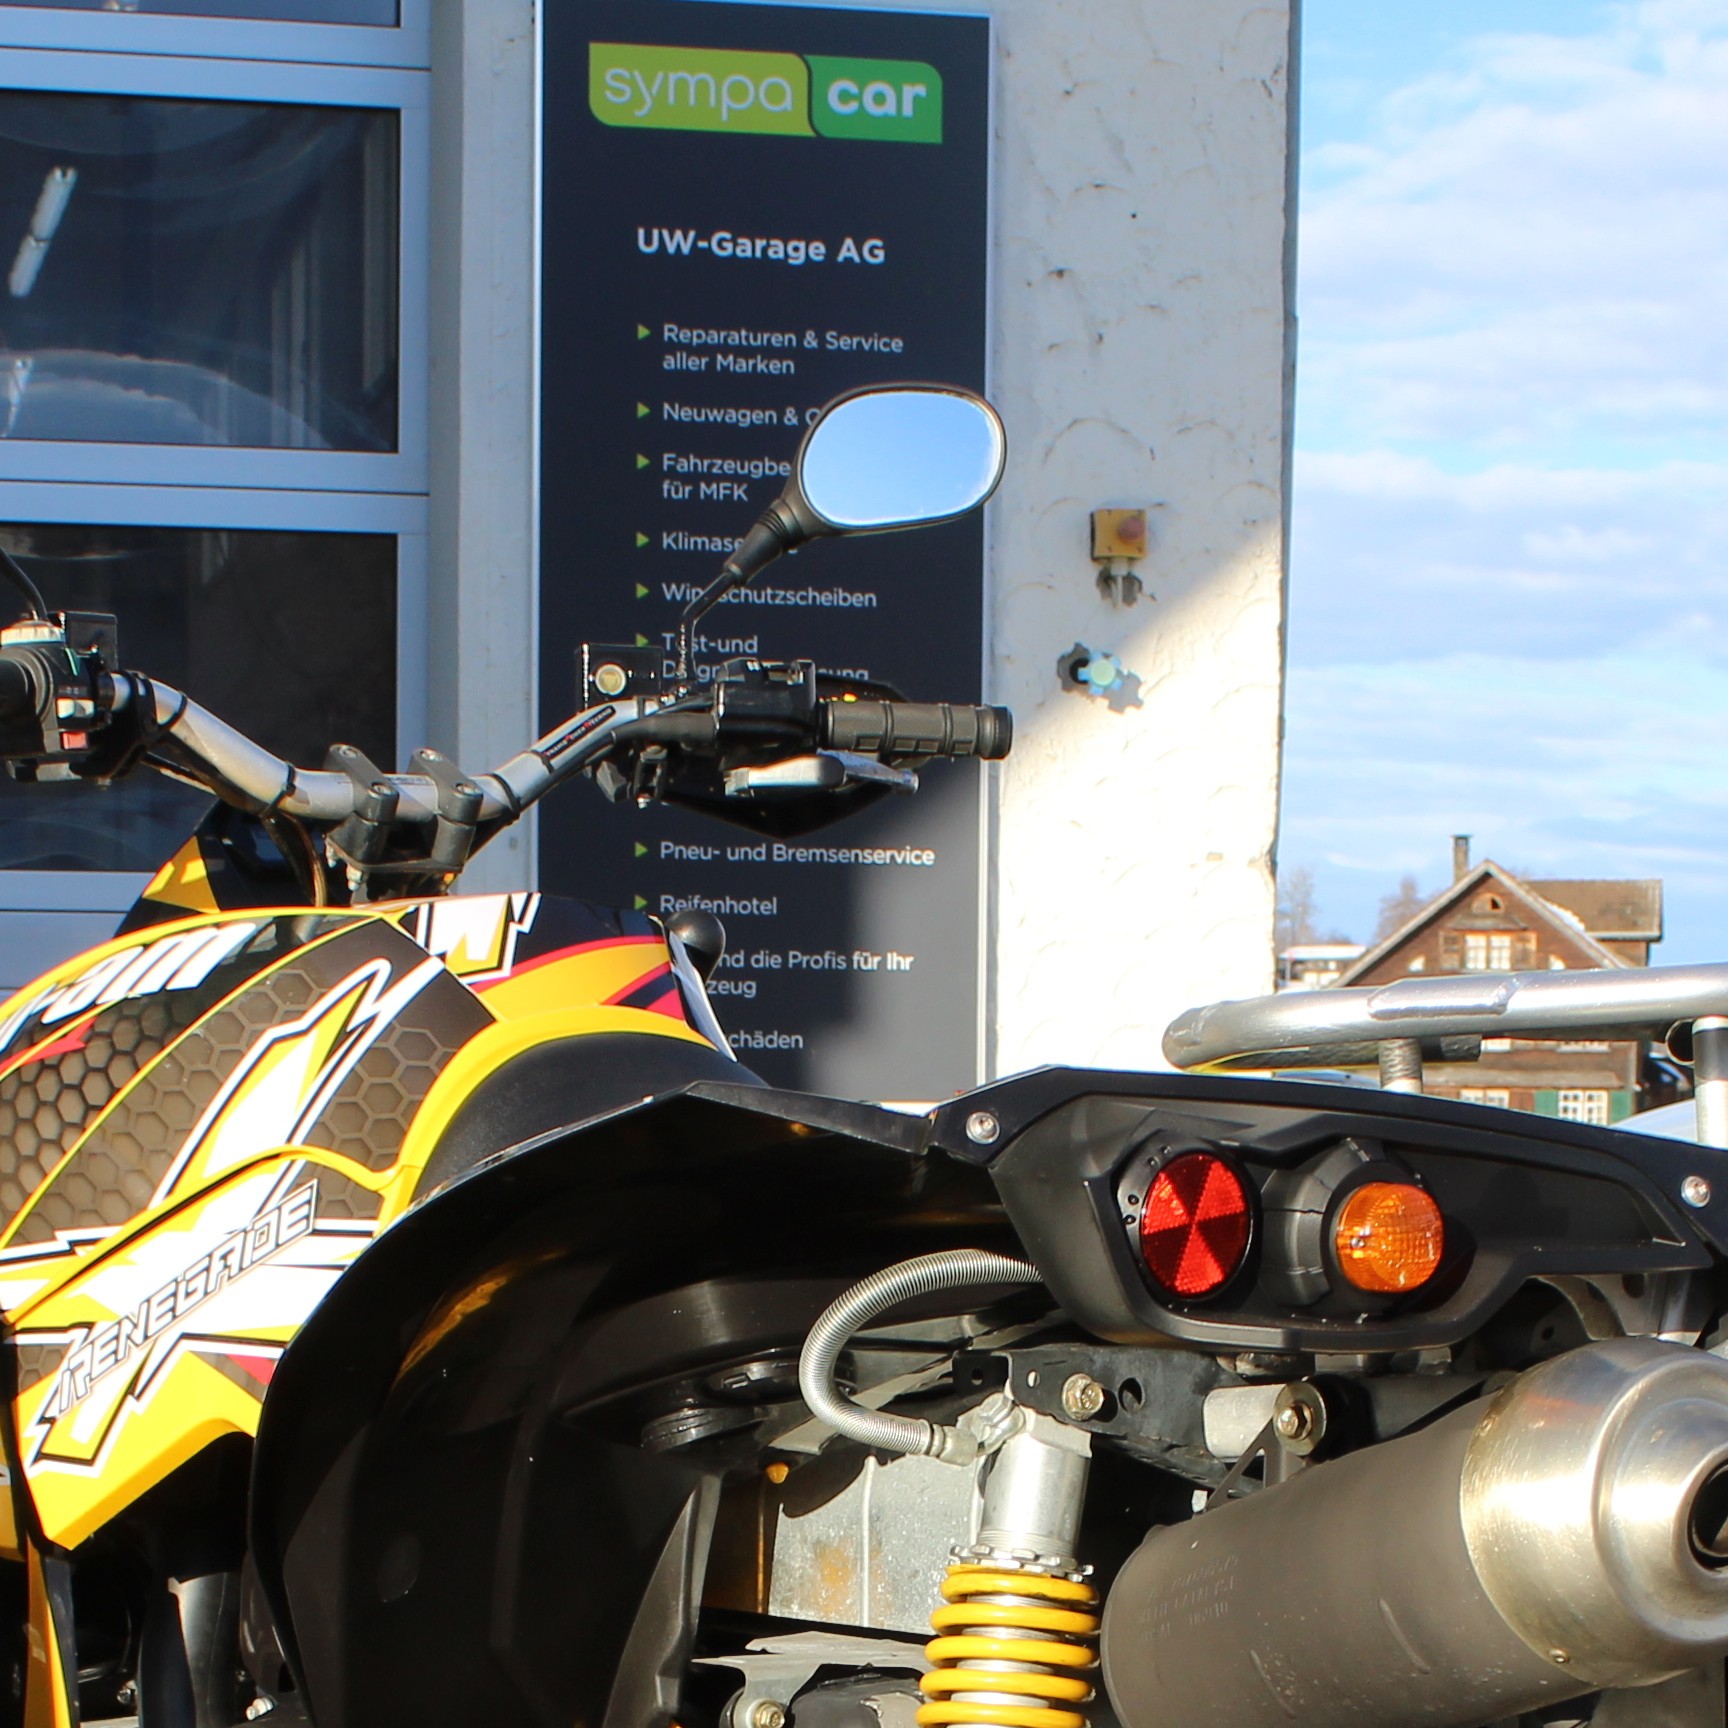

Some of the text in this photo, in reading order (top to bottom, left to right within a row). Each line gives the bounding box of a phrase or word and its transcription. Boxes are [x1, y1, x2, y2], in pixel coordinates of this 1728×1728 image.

[604, 67, 927, 122] sympa car
[636, 226, 886, 265] UW-Garage AG
[663, 323, 904, 352] Reparaturen & Service
[663, 351, 795, 374] aller Marken
[662, 403, 778, 427] Neuwagen
[783, 407, 799, 426] &
[662, 453, 791, 478] Fahrzeugbe
[662, 480, 749, 501] für MFK
[662, 582, 877, 607] Winschutzscheiben
[662, 633, 758, 654] Tst-und
[660, 842, 935, 866] Pneu- und Bremsenservice
[660, 895, 778, 916] Reifenhotel
[750, 951, 782, 969] die
[788, 951, 848, 970] Profis
[852, 952, 881, 971] für
[886, 952, 914, 971] Ihr
[706, 979, 757, 998] zeug
[728, 1030, 804, 1049] chäden
[57, 1179, 318, 1418] RENEGADE
